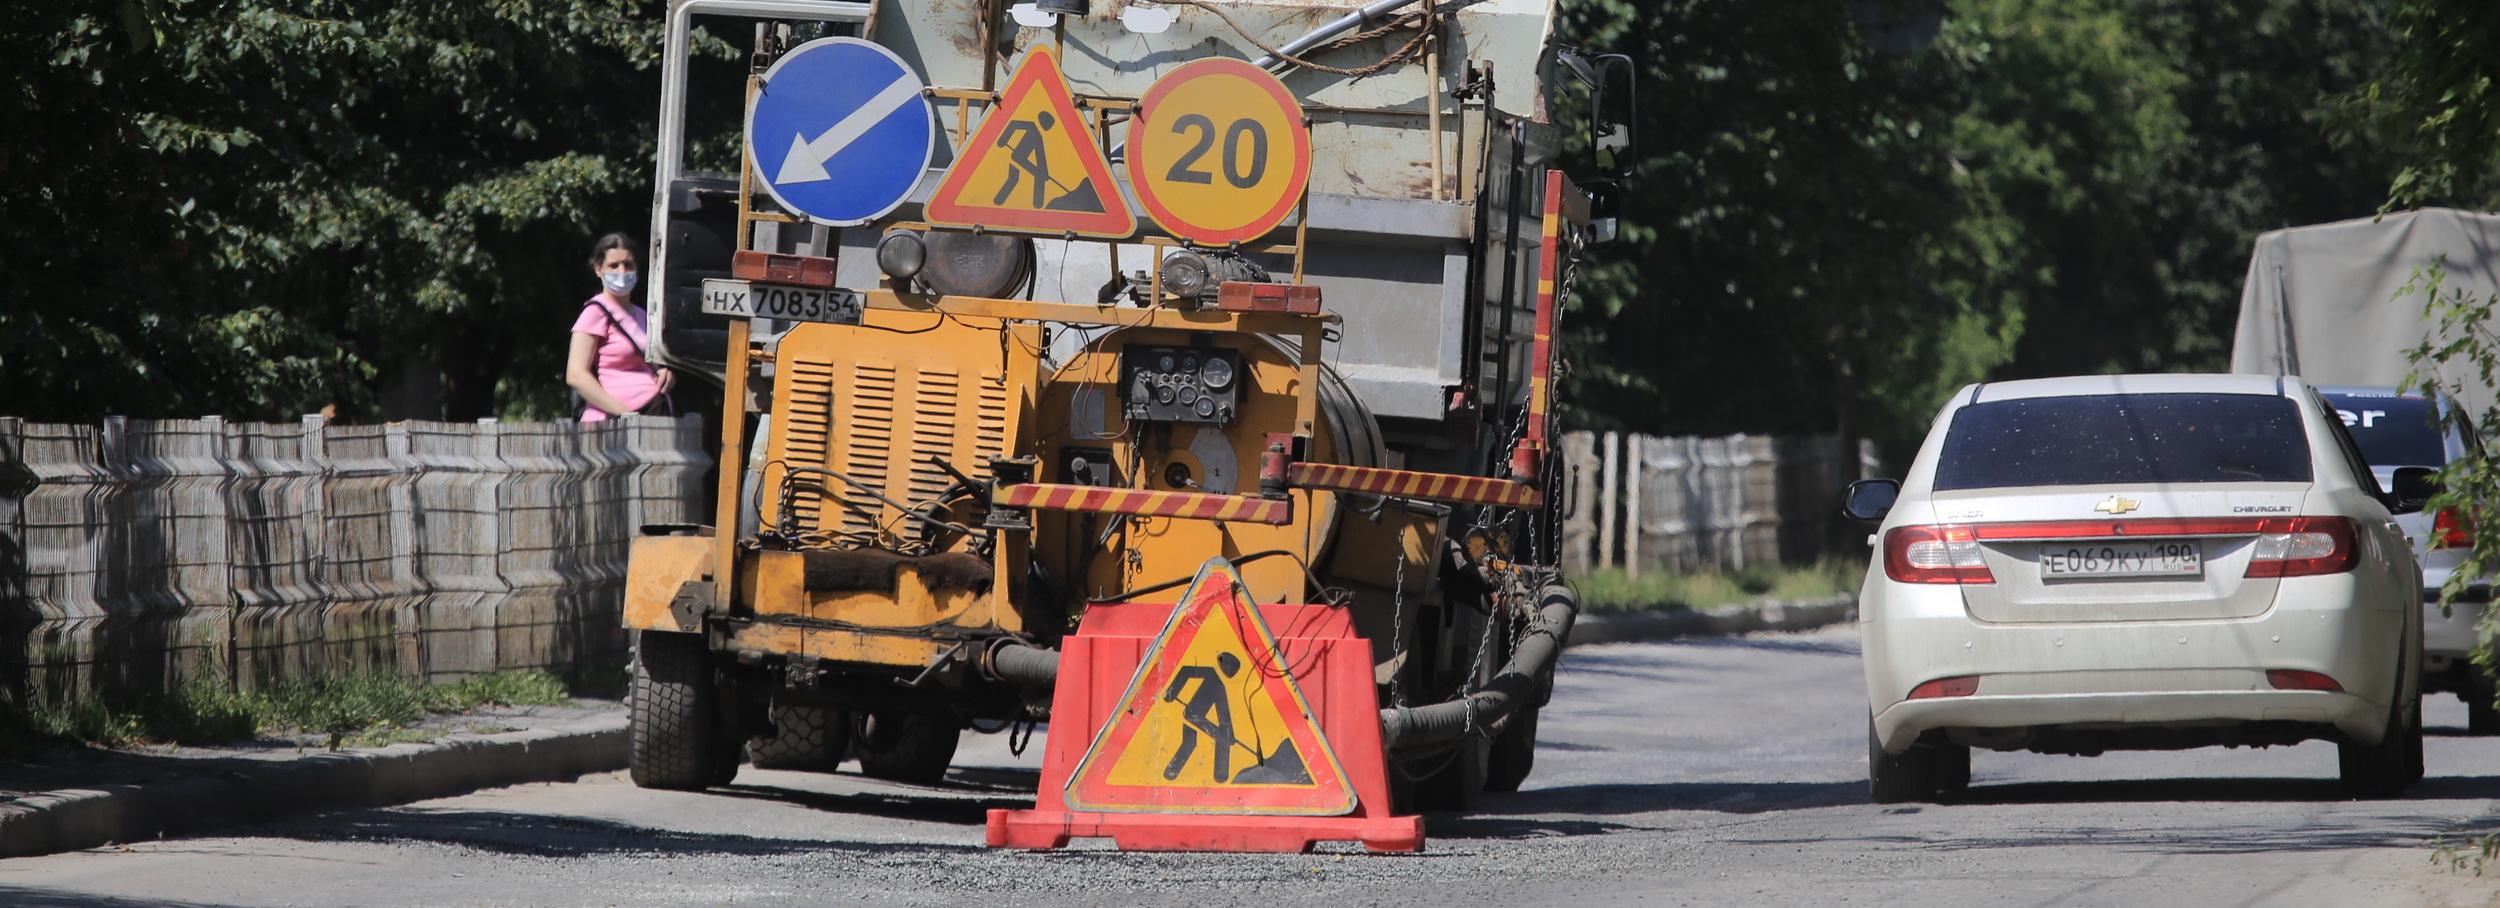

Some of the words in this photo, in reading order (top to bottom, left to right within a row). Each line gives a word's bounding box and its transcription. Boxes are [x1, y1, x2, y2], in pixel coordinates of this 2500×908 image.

[1165, 113, 1268, 189] 20
[753, 288, 821, 317] 7083
[828, 294, 855, 313] 54
[2233, 505, 2293, 513] CHEVROLET
[2155, 544, 2192, 563] 190
[2163, 563, 2182, 571] RUS
